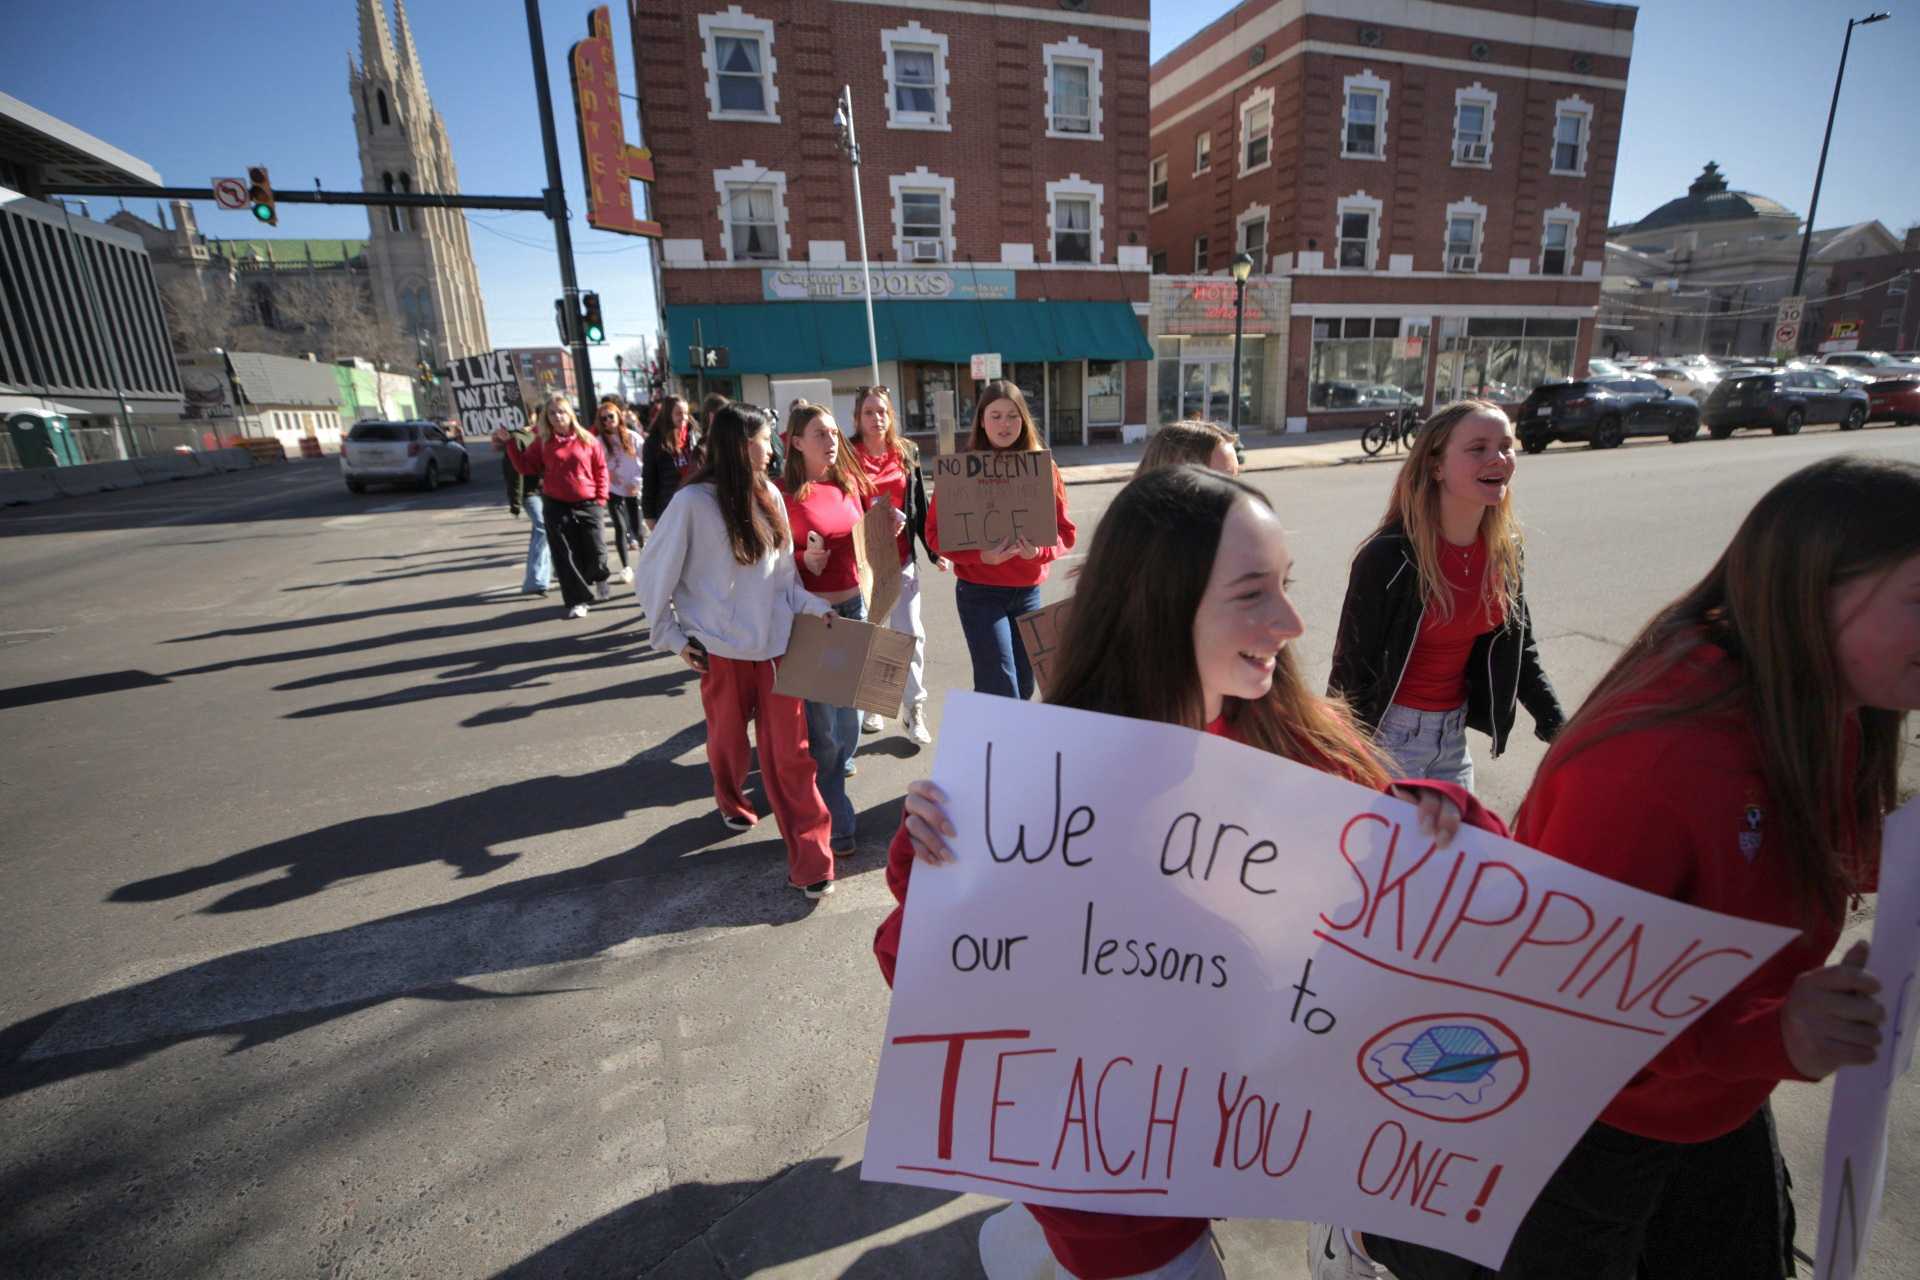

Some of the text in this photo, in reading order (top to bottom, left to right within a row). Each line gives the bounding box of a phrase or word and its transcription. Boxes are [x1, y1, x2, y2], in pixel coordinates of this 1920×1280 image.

[579, 56, 609, 206] HOTEL
[841, 271, 947, 296] BOOKS
[446, 350, 515, 388] I LIKE
[457, 384, 508, 409] MY ICE
[463, 405, 525, 436] CRUSHED
[937, 451, 1042, 478] NO DECENT
[954, 508, 1032, 546] ICE
[985, 741, 1754, 1019] We are SKIPPING
[952, 901, 1336, 1034] our lessons to
[892, 1029, 1504, 1224] TEACH YOU ONE!
